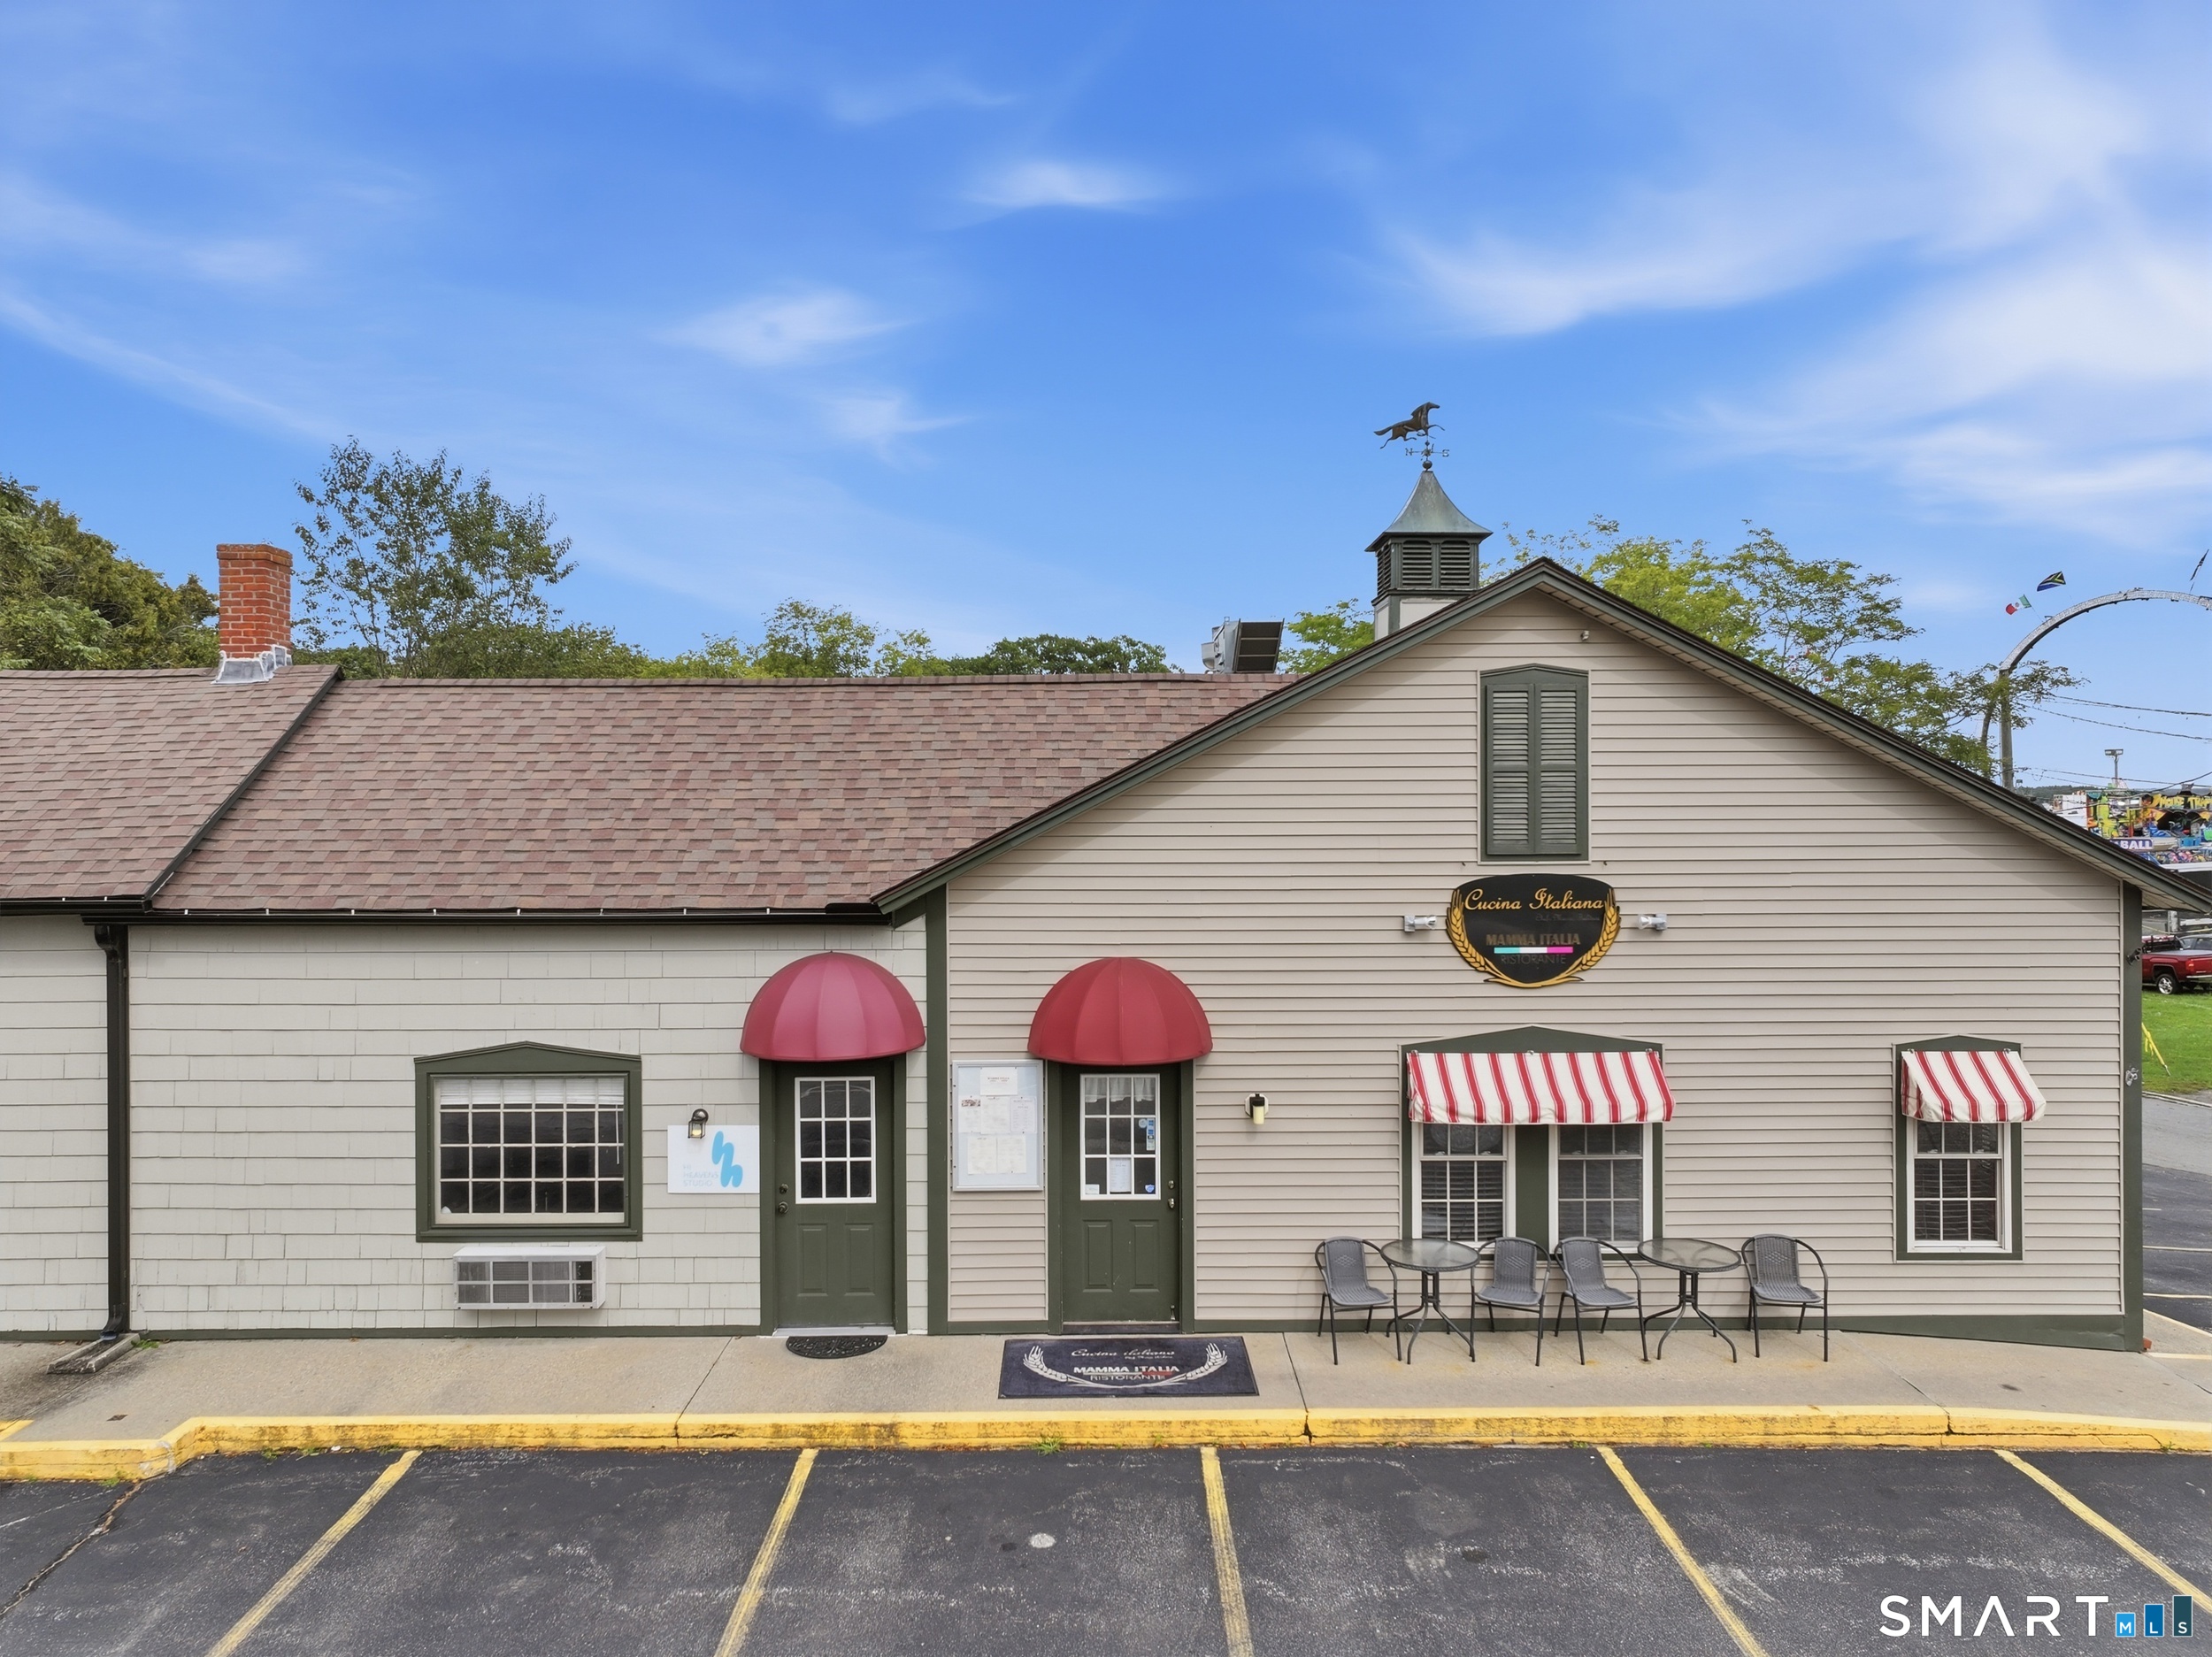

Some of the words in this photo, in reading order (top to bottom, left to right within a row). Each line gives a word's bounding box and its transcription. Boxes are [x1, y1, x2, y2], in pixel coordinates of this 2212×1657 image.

[1464, 887, 1523, 911] Cucina
[1529, 887, 1604, 910] Italiana
[1486, 933, 1537, 946] MAMMA
[1539, 932, 1580, 945] ITALIA
[1501, 954, 1566, 964] RISTORANTE
[1071, 1348, 1118, 1357] Cucina
